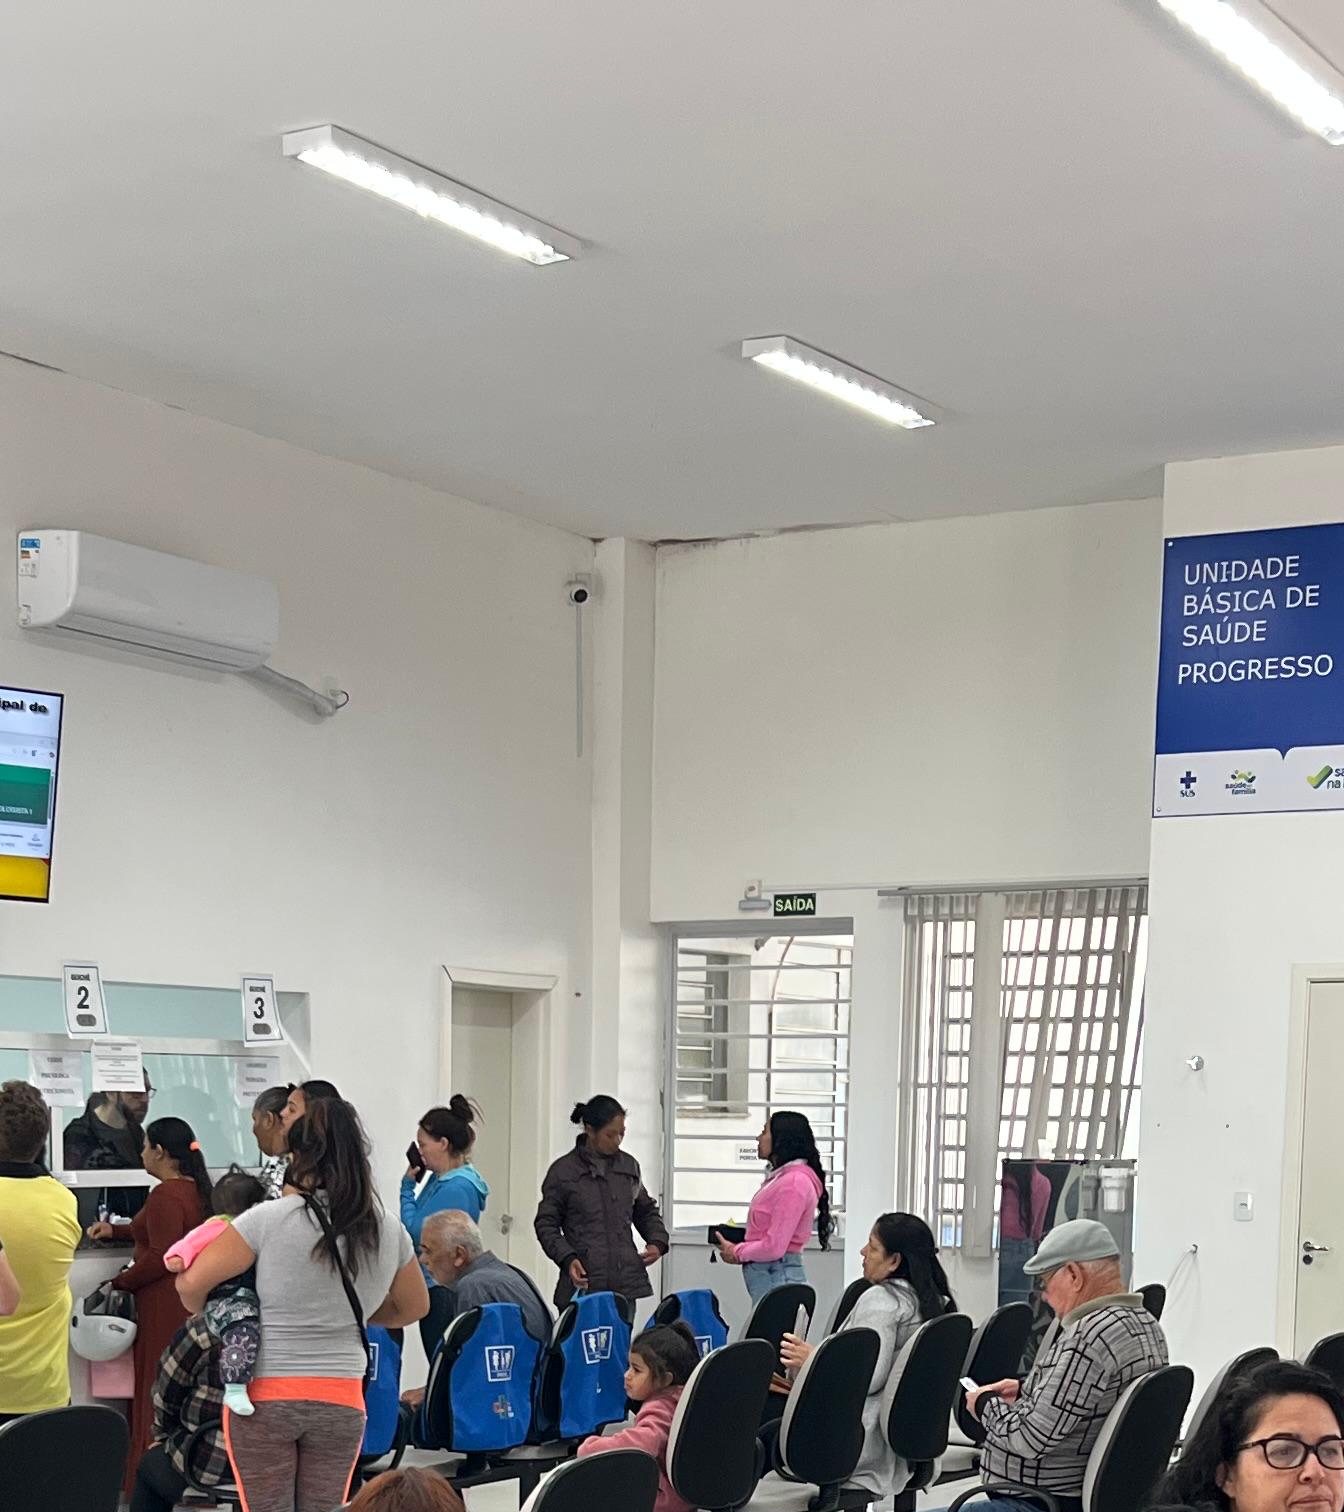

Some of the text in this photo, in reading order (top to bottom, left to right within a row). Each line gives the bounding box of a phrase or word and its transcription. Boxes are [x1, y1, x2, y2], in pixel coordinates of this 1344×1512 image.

[1185, 556, 1299, 585] UNIDADE
[1183, 585, 1319, 616] BÁSICA DE
[1182, 616, 1267, 646] SAÚDE
[1178, 655, 1333, 684] PROGRESSO
[29, 703, 47, 713] de
[1327, 780, 1341, 789] na
[775, 897, 814, 913] SAÍDA
[77, 986, 89, 1009] 2
[254, 997, 264, 1019] 3
